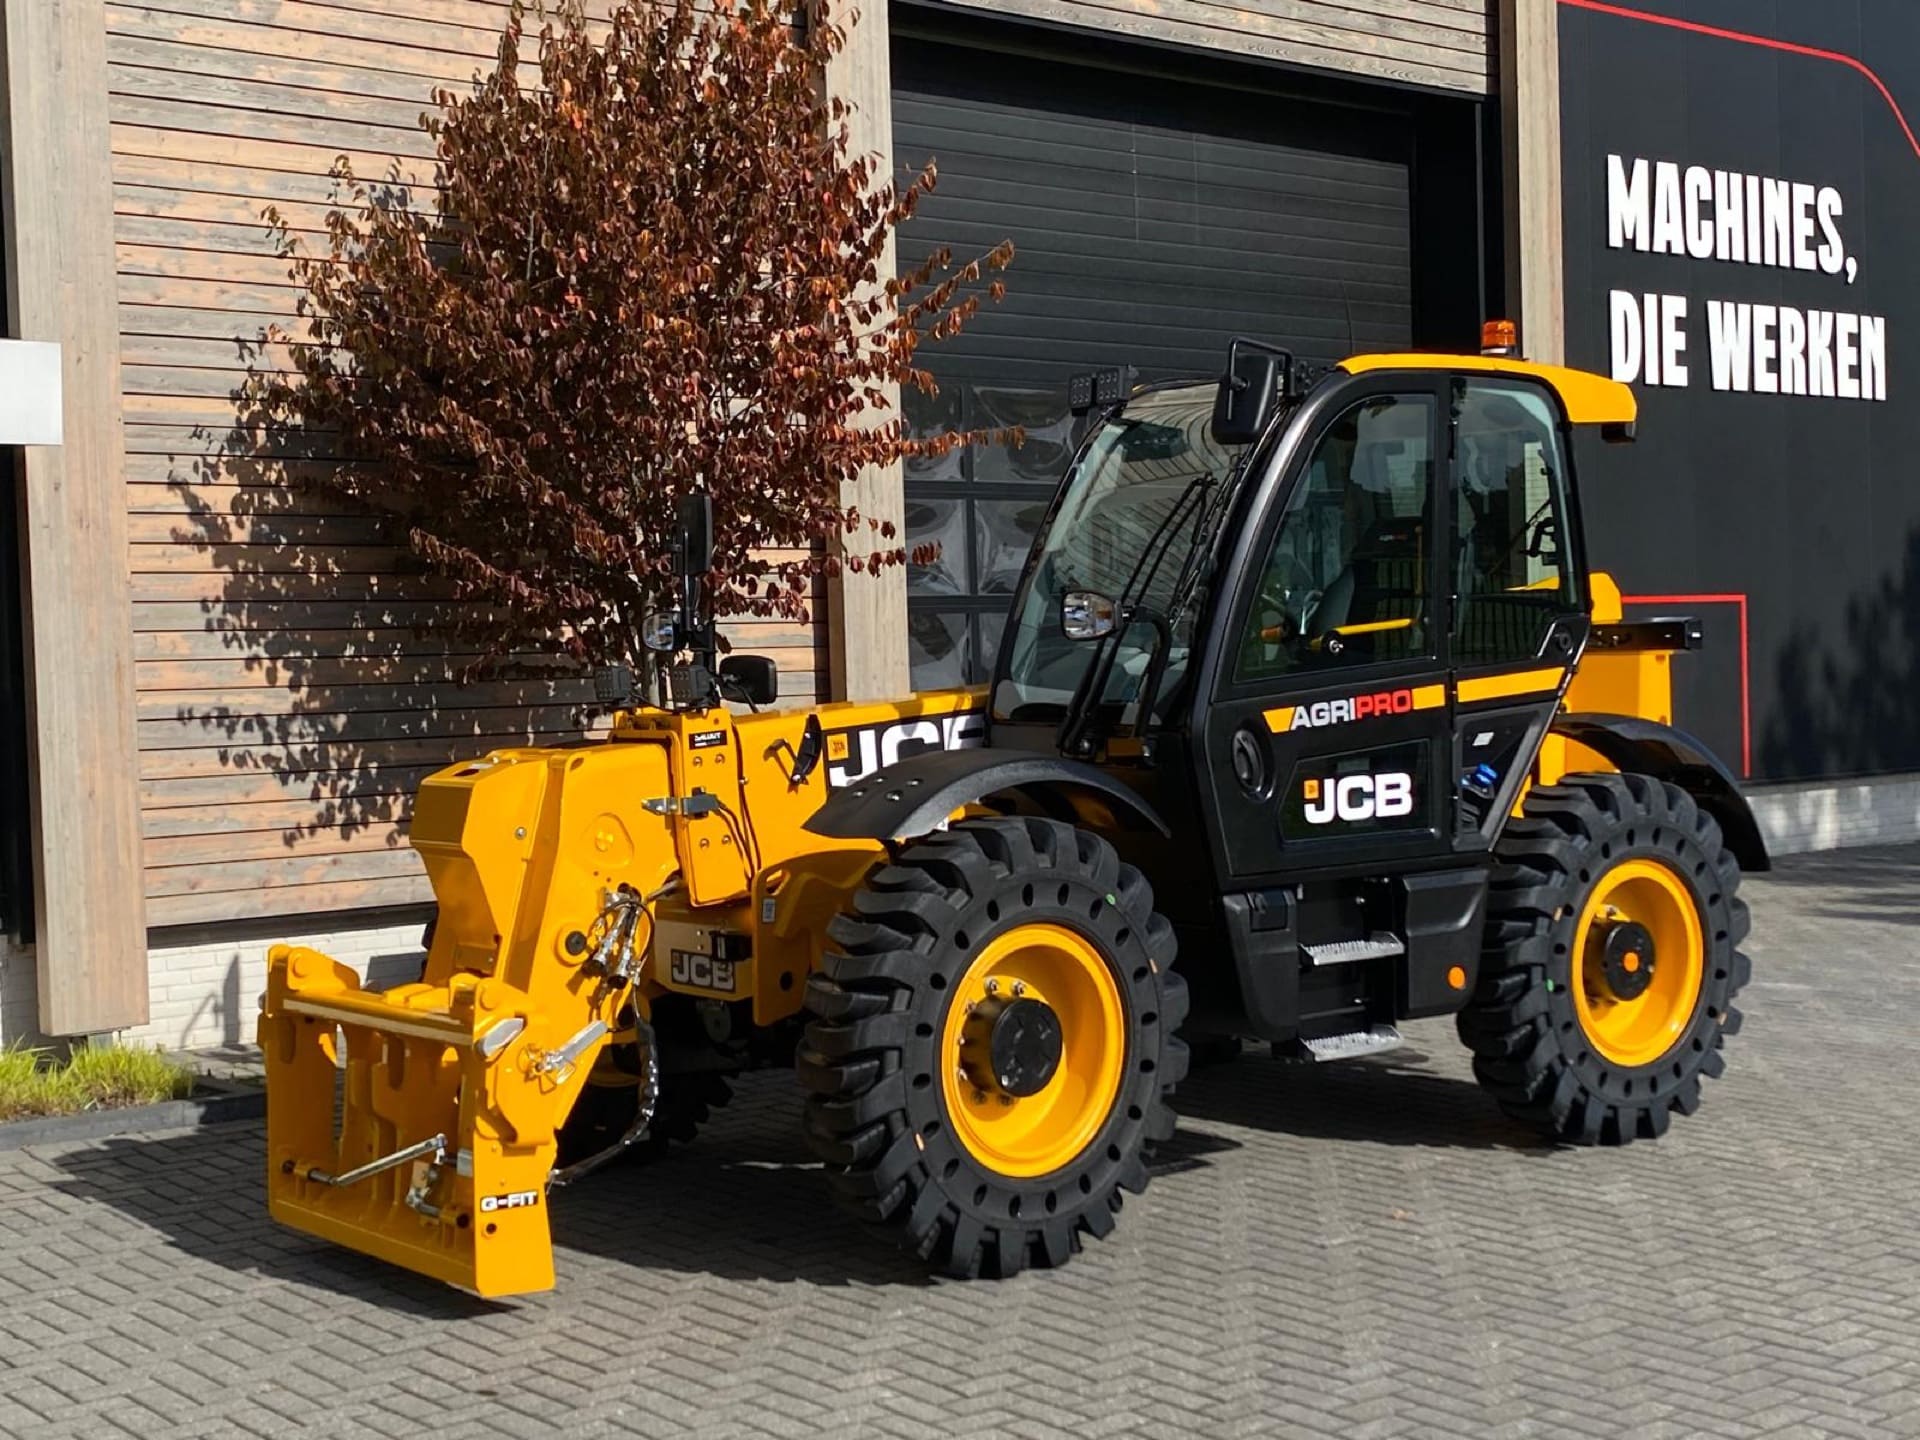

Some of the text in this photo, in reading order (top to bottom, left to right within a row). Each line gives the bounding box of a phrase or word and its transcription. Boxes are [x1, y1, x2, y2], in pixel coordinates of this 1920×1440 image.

[1607, 154, 1858, 284] MACHINES,
[1609, 289, 1887, 401] DIE WERKEN
[1290, 689, 1413, 731] AGRIPRO
[1303, 772, 1413, 824] JCB
[672, 951, 735, 991] JCB
[480, 1190, 538, 1212] G-FIT
